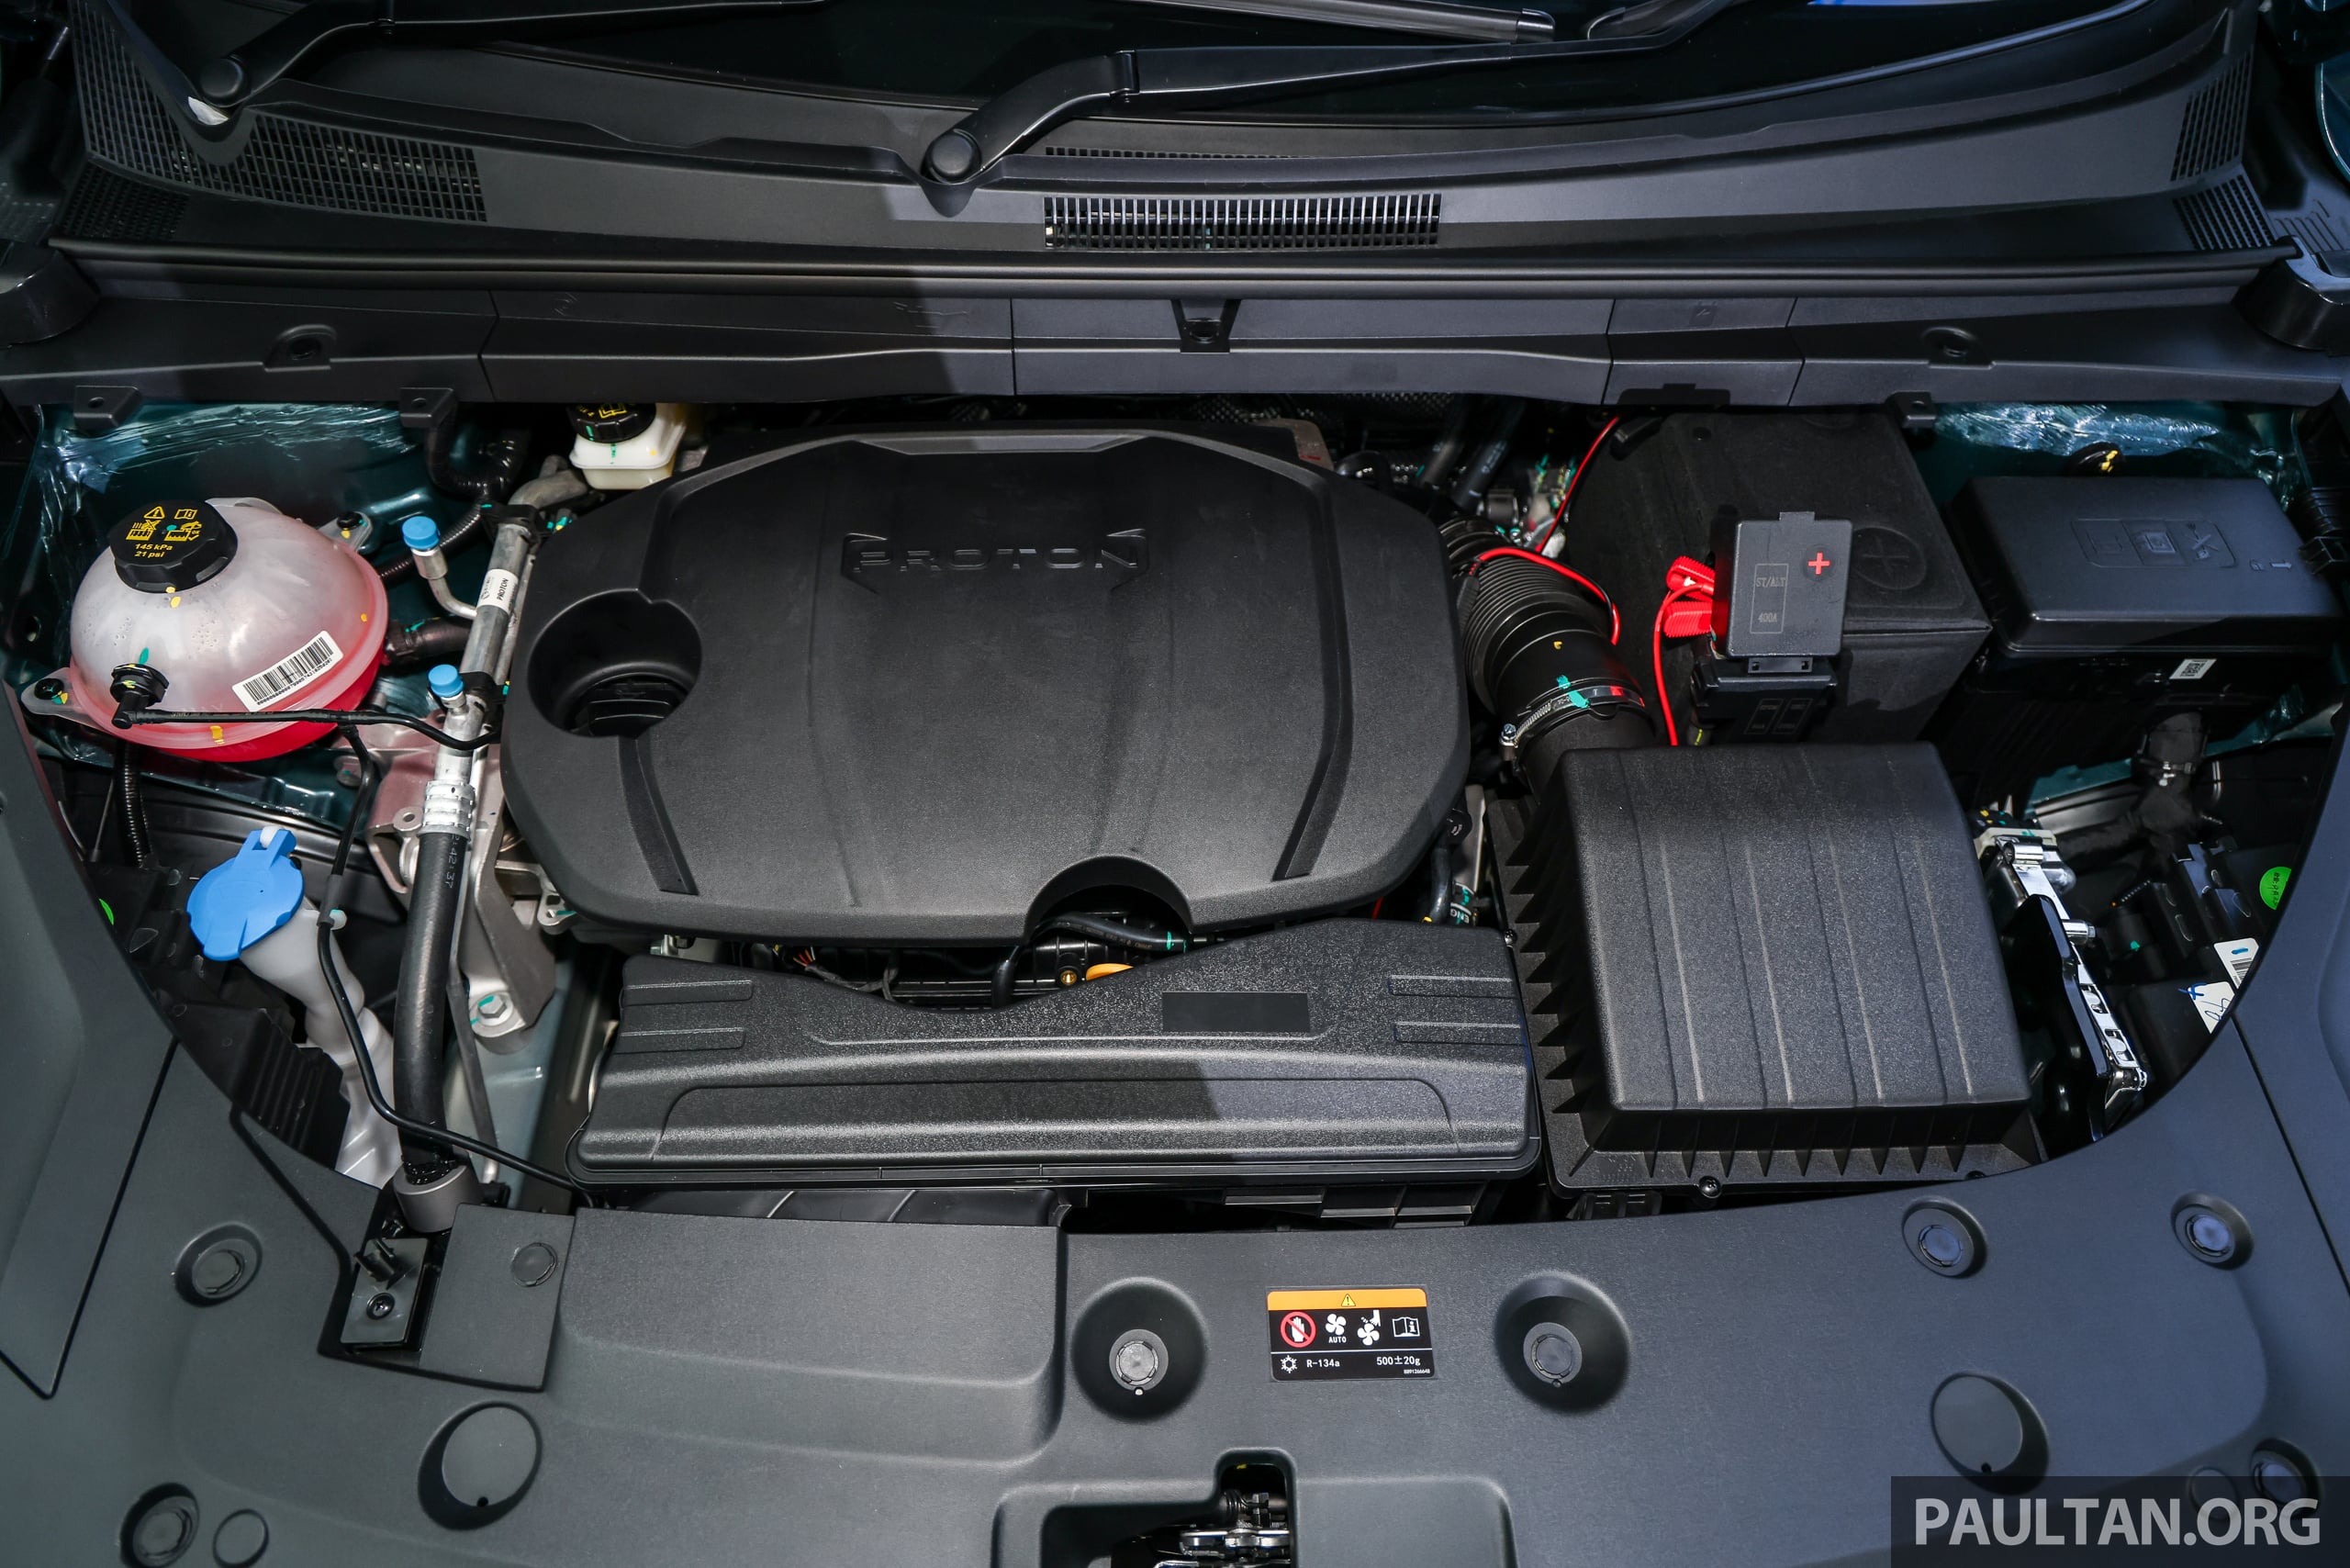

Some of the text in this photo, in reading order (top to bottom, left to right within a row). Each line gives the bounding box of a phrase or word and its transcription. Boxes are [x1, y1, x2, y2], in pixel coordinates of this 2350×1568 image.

[853, 547, 1139, 572] PROTON
[1755, 577, 1786, 588] ST/ALT
[497, 577, 509, 601] PROTON
[1758, 611, 1778, 623] 400A
[1306, 1356, 1421, 1368] R-134a 500±20g
